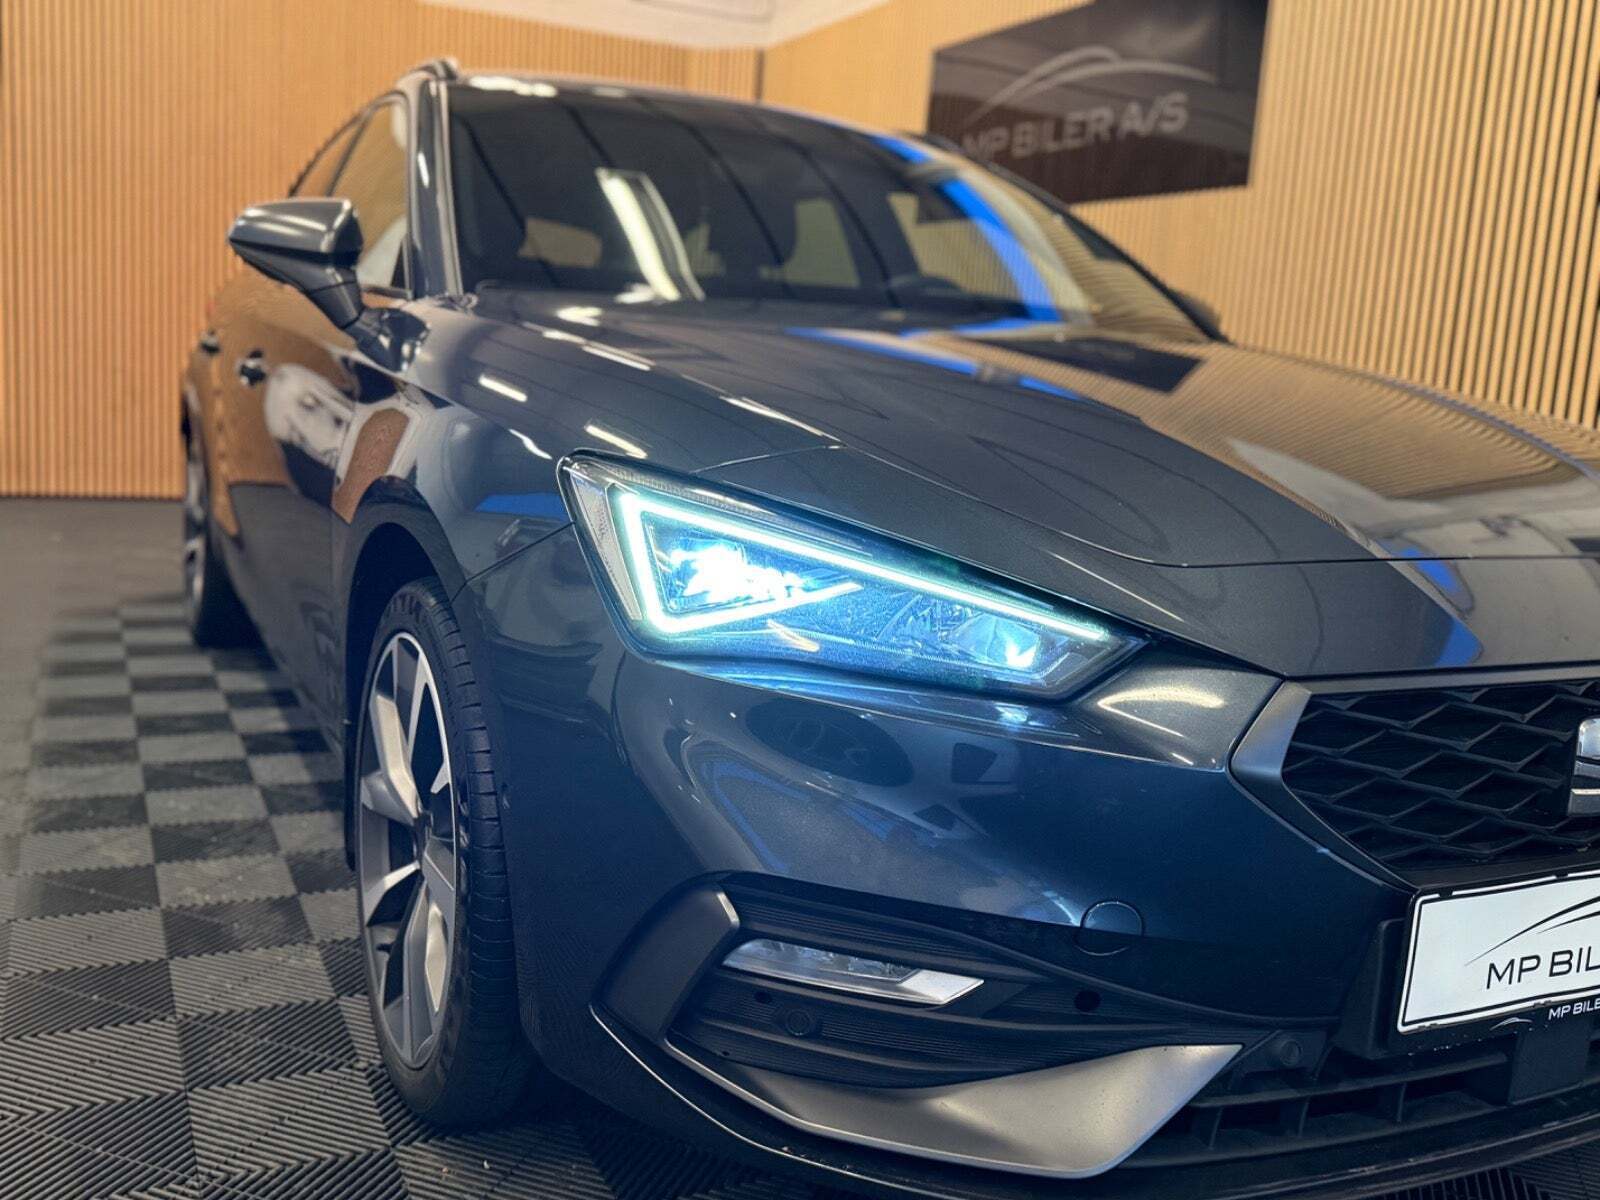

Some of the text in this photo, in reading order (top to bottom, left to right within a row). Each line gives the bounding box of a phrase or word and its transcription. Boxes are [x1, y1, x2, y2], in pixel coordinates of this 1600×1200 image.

[1010, 106, 1115, 159] BILER
[1117, 91, 1189, 141] A/S
[1486, 946, 1600, 989] MP BIL
[1548, 1004, 1571, 1020] MP
